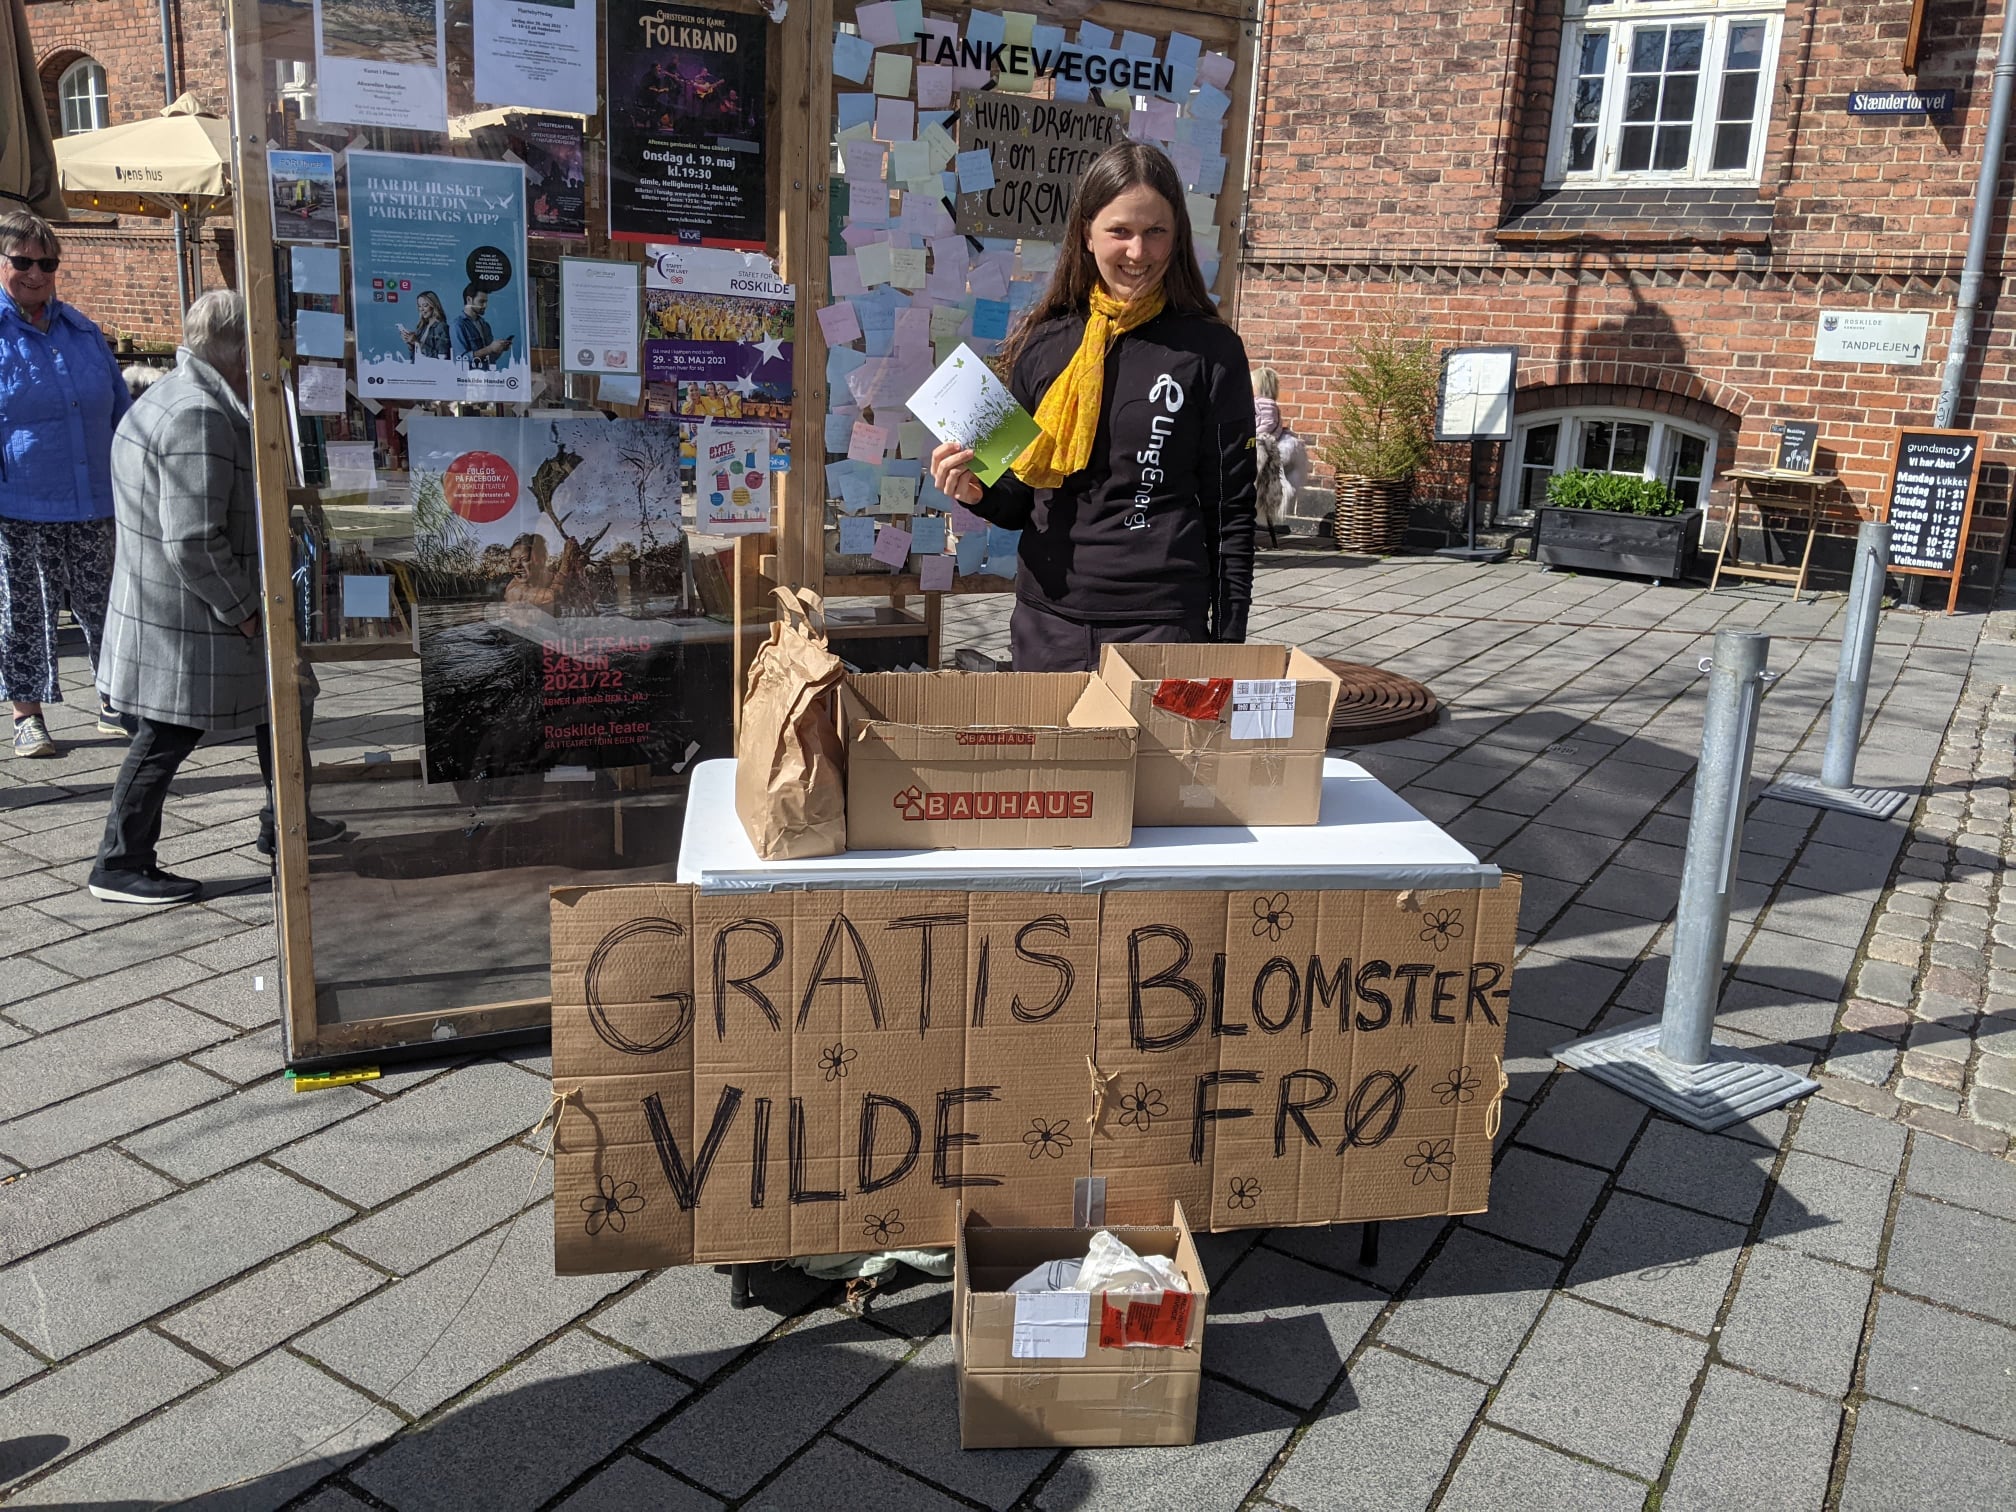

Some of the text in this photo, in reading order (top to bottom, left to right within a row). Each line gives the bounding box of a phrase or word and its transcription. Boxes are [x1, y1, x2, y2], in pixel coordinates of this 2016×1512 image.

[640, 15, 737, 53] FOLKBAND
[914, 32, 1174, 93] TANKEVÆGGEN
[1853, 93, 1947, 110] Stændertorvet
[975, 101, 1113, 145] HVAD DRØMMER
[642, 150, 736, 170] Onsdag d. 19. maj
[1009, 143, 1036, 172] OM
[115, 166, 163, 184] Byens hus
[367, 177, 483, 197] HAR DU HUSKET
[369, 191, 468, 210] AT STILLE DIN
[368, 205, 499, 226] PARKERINGS APP?
[738, 270, 759, 279] STAFET
[730, 279, 790, 295] ROSKILDE
[1844, 318, 1883, 326] ROSKILDE
[1841, 340, 1911, 352] TANDPLEJEN
[652, 355, 666, 364] 29.
[673, 356, 687, 364] 30.
[688, 356, 706, 364] MAJ
[707, 356, 726, 365] 2021
[1907, 443, 1961, 457] grundsmag
[1919, 456, 1935, 467] har
[455, 474, 465, 482] PÅ
[466, 467, 496, 475] FØLG OS
[1897, 471, 1968, 487] Mandag Lukket
[1896, 483, 1930, 497] Tirsdag
[1894, 494, 1927, 509] Onsdag
[1891, 508, 1929, 522] Torsdag
[1894, 554, 1944, 569] Velkommen
[542, 635, 652, 656] BILLETSALG
[542, 654, 609, 674] SÆSON
[543, 670, 624, 691] 2021/22
[544, 720, 651, 739] Roskilde Teater
[968, 732, 1036, 745] BAUHAUS
[927, 793, 1091, 818] BAUHAUS
[585, 912, 1510, 1056] GRATIS BLOMSTER-
[643, 1064, 1418, 1209] VILDE FRØ
